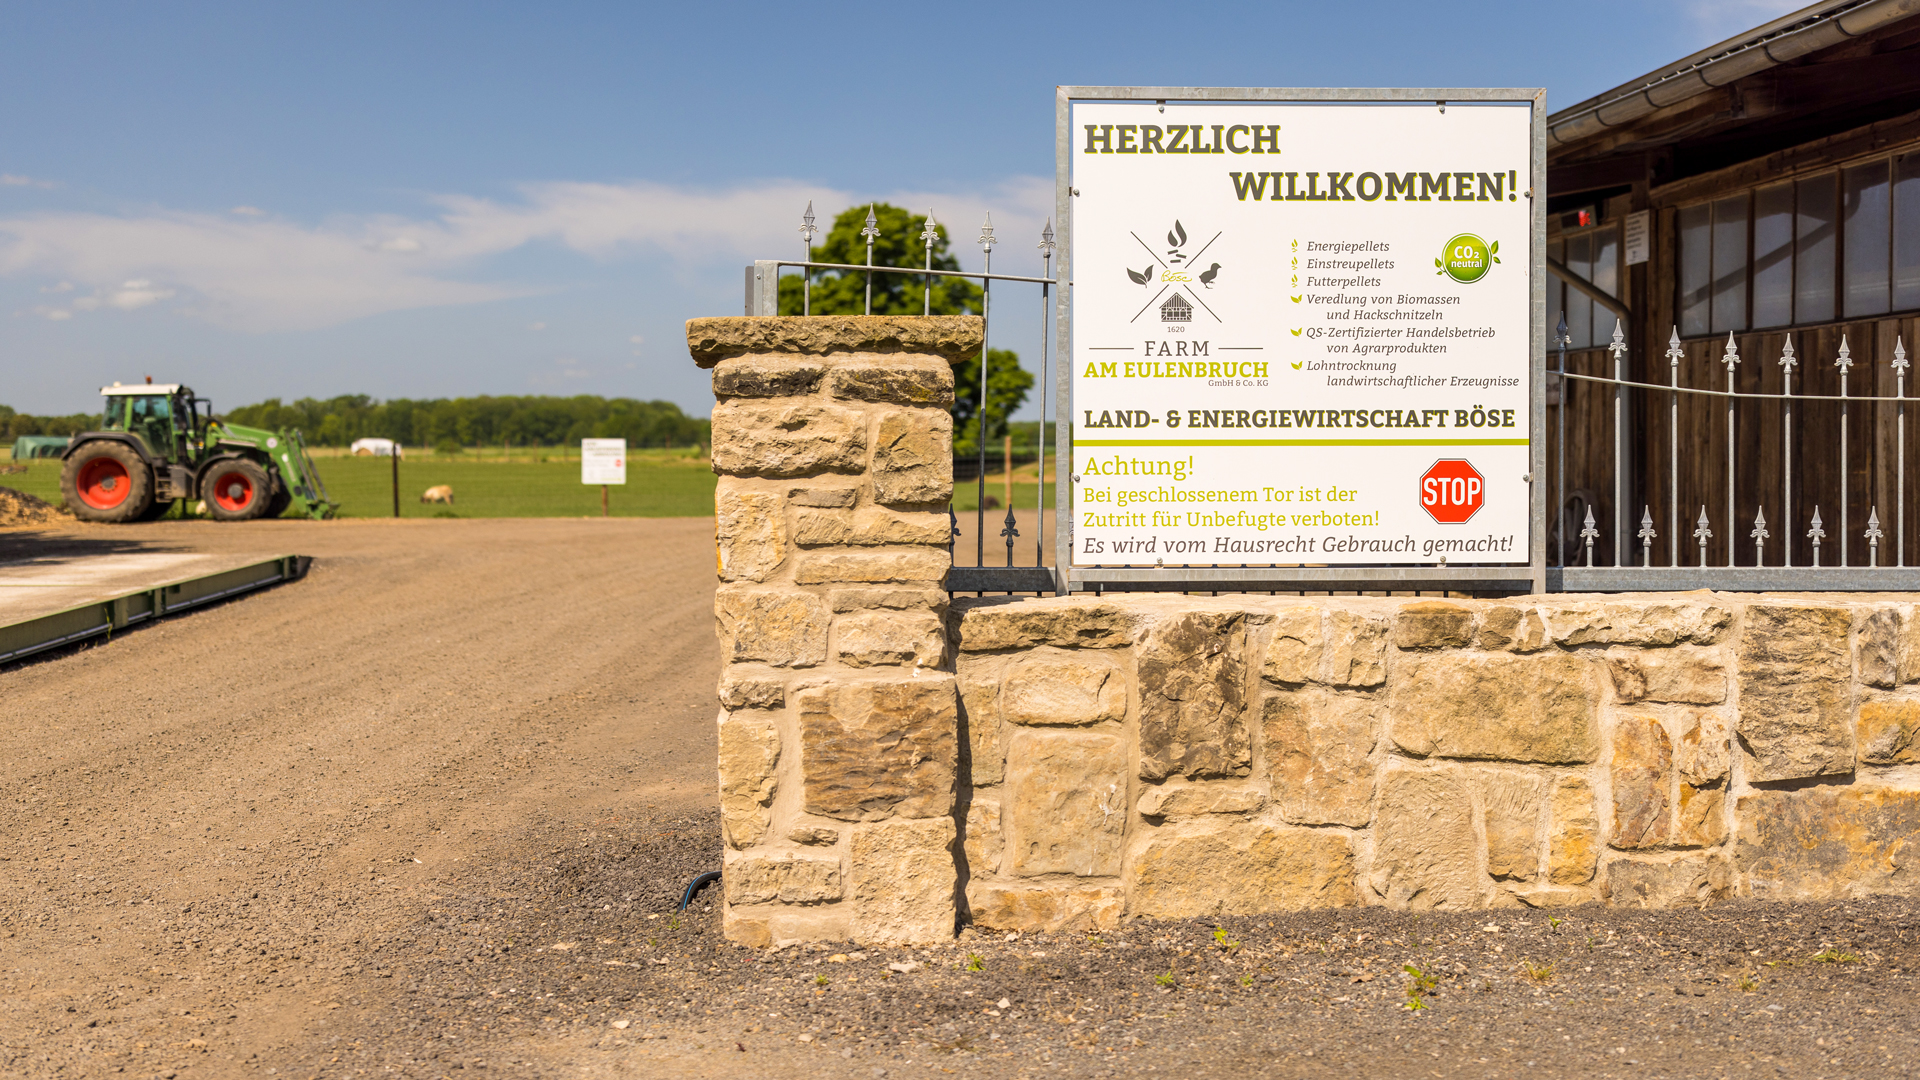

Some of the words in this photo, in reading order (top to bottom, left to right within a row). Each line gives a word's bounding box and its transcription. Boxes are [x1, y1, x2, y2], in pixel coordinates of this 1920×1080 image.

[1083, 124, 1282, 156] HERZLICH
[1228, 169, 1518, 203] WILLKOMMEN!
[1306, 240, 1390, 255] Energiepellets
[1306, 257, 1395, 272] Einstreupellets
[1451, 258, 1483, 268] neutral
[1306, 275, 1382, 290] Futterpellets
[1306, 293, 1368, 308] Veredlung
[1370, 296, 1393, 305] von
[1396, 293, 1461, 305] Biomassen
[1326, 308, 1351, 320] und
[1353, 308, 1443, 321] Hackschnitzeln
[1167, 325, 1186, 333] 1620
[1306, 326, 1404, 341] QS-Zertifizierter
[1405, 326, 1496, 338] Handelsbetrieb
[1144, 340, 1210, 357] FARM
[1326, 344, 1349, 354] von
[1351, 342, 1447, 357] Agrarprodukten
[1082, 361, 1118, 379] AM
[1124, 362, 1269, 378] EULENBRUCH
[1306, 359, 1397, 374] Lohntrocknung
[1207, 378, 1234, 387] GmbH
[1235, 379, 1241, 387] &
[1242, 379, 1255, 387] Co.
[1256, 379, 1269, 387] KG
[1326, 374, 1448, 390] landwirtschaftlicher
[1449, 375, 1520, 390] Erzeugnisse
[1083, 409, 1160, 429] LAND-
[1165, 409, 1182, 429] &
[1187, 409, 1450, 429] ENERGIEWIRTSCHAFT
[1453, 403, 1516, 429] BÖSE
[1083, 455, 1194, 481] Achtung!
[1083, 486, 1112, 503] Bei
[1116, 485, 1259, 508] geschlossenem
[1262, 486, 1295, 503] Tor
[1298, 485, 1322, 503] ist
[1326, 485, 1358, 502] der
[1423, 477, 1482, 506] STOP
[1083, 510, 1147, 528] Zutritt
[1151, 510, 1182, 528] für
[1185, 509, 1287, 532] Unbefugte
[1290, 509, 1379, 527] verboten!
[1083, 537, 1105, 554] Es
[1112, 536, 1157, 554] wird
[1164, 541, 1207, 554] vom
[1214, 535, 1316, 554] Hausrecht
[1323, 535, 1417, 554] Gebrauch
[1423, 535, 1514, 557] gemacht!
